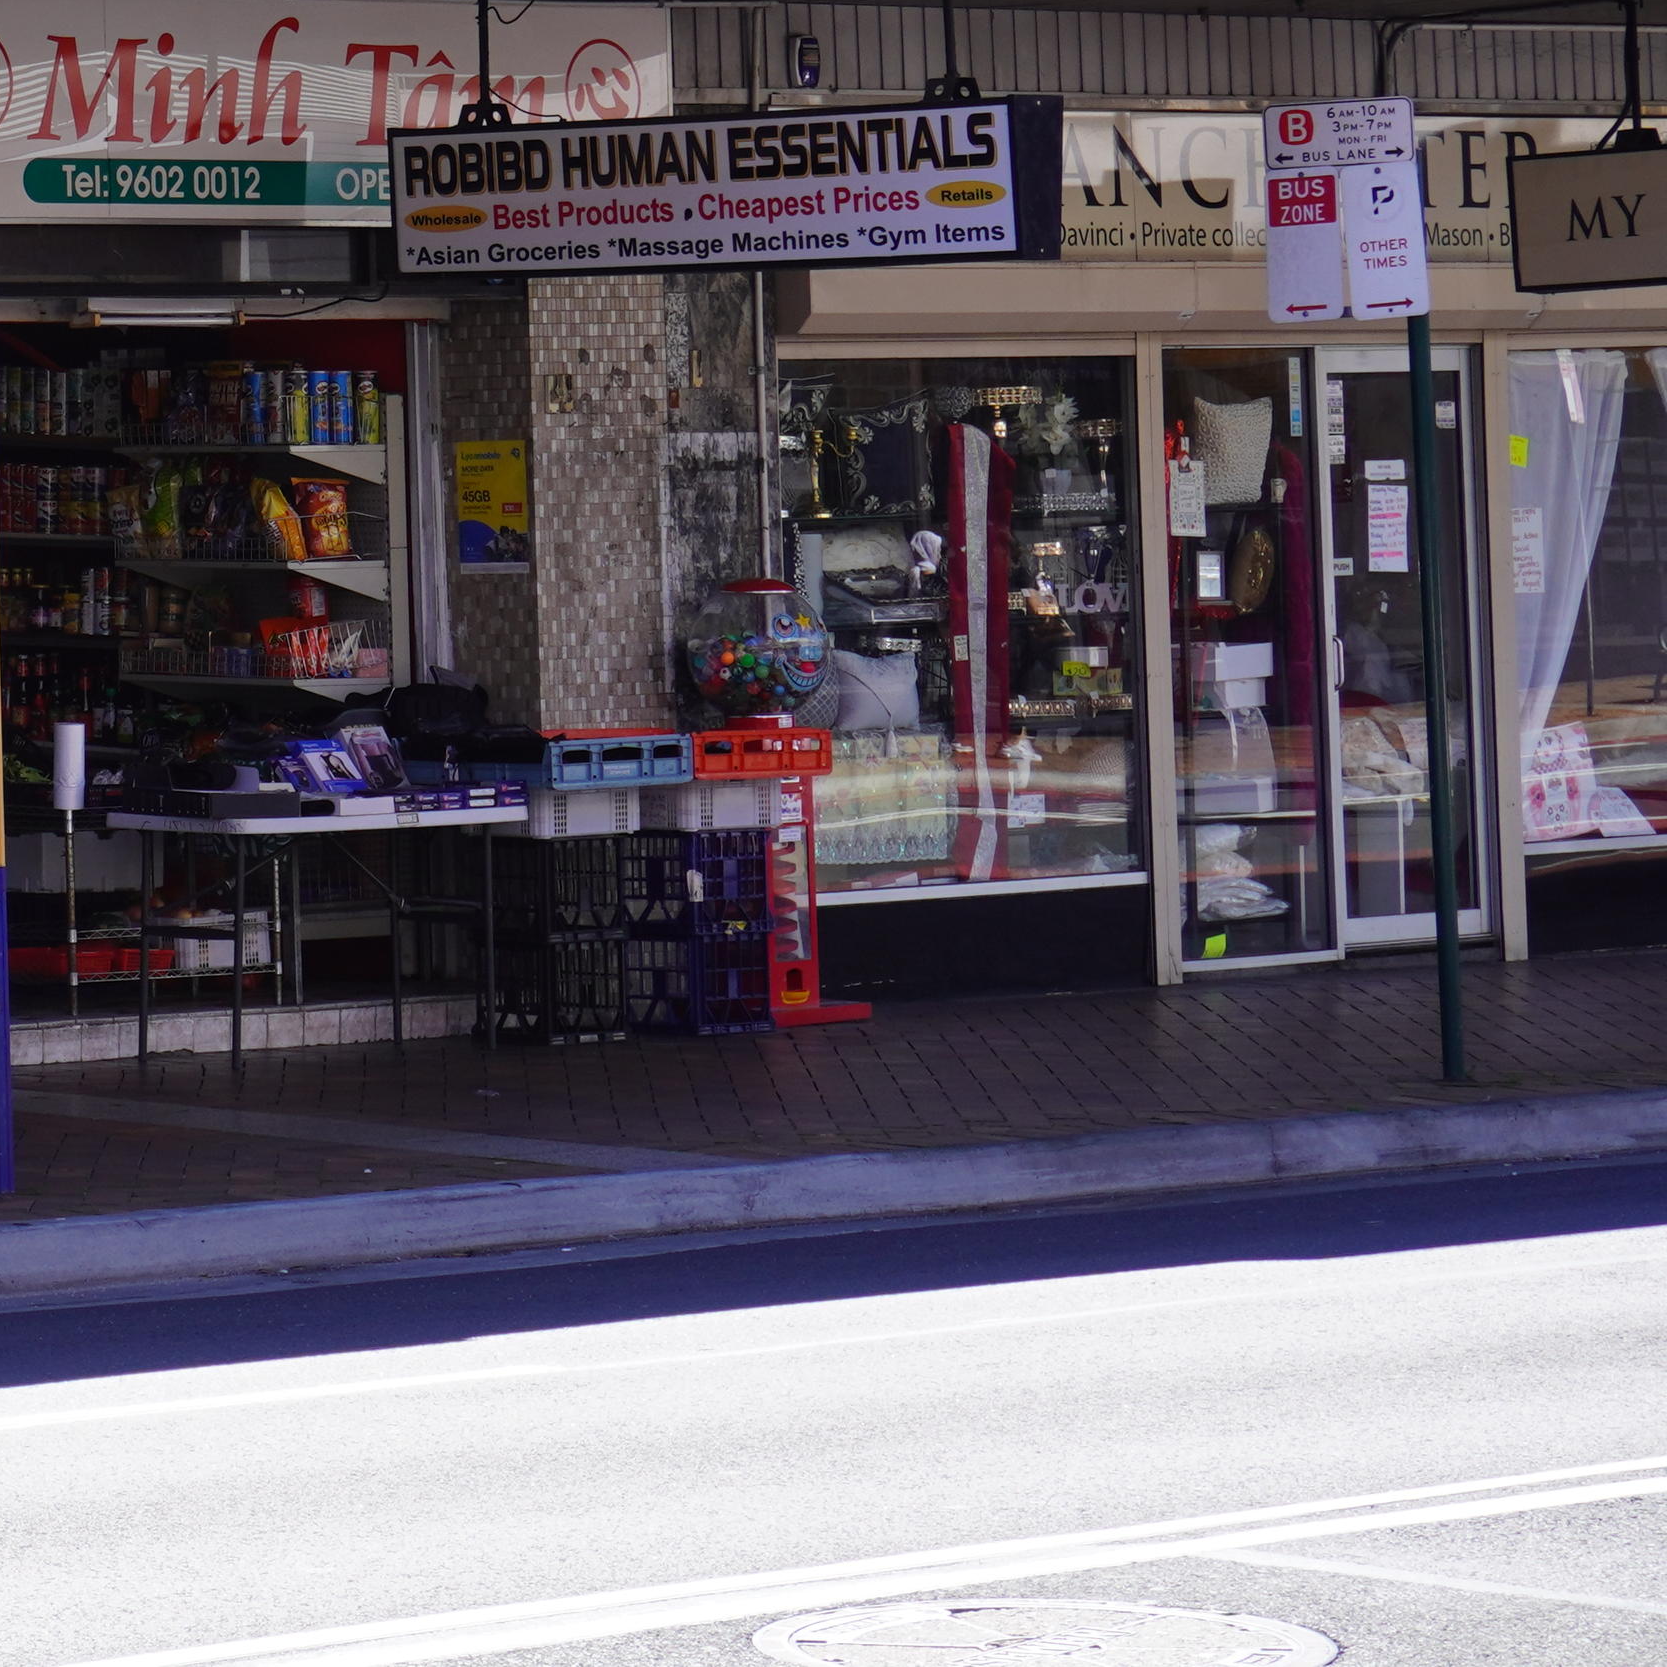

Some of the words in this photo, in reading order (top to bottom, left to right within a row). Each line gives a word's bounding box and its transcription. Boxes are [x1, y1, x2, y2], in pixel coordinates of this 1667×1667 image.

[27, 16, 309, 147] Minh
[1287, 113, 1308, 143] B
[1338, 136, 1359, 146] MON
[1370, 134, 1387, 143] FRI
[403, 136, 552, 199] ROBIBD
[561, 128, 717, 193] HUMAN
[727, 111, 998, 182] ESSENTIALS
[1302, 151, 1331, 163] BUS
[1337, 148, 1377, 162] LANE
[62, 163, 109, 199] Tel:
[115, 163, 186, 201] 9602
[192, 163, 262, 201] 0012
[940, 185, 994, 204] Retails
[1278, 179, 1326, 200] BUS
[492, 201, 551, 231] Best
[557, 197, 674, 228] Products
[698, 189, 827, 224] Cheapest
[833, 184, 920, 215] Prices
[1280, 203, 1326, 225] ZONE
[411, 212, 483, 229] Wholesale
[1567, 194, 1647, 242] MY
[730, 228, 849, 254] Machines
[934, 221, 1005, 246] Items
[1142, 221, 1207, 248] Private
[1359, 238, 1408, 254] OTHER
[486, 240, 600, 265] Groceries
[1363, 255, 1408, 271] TIMES
